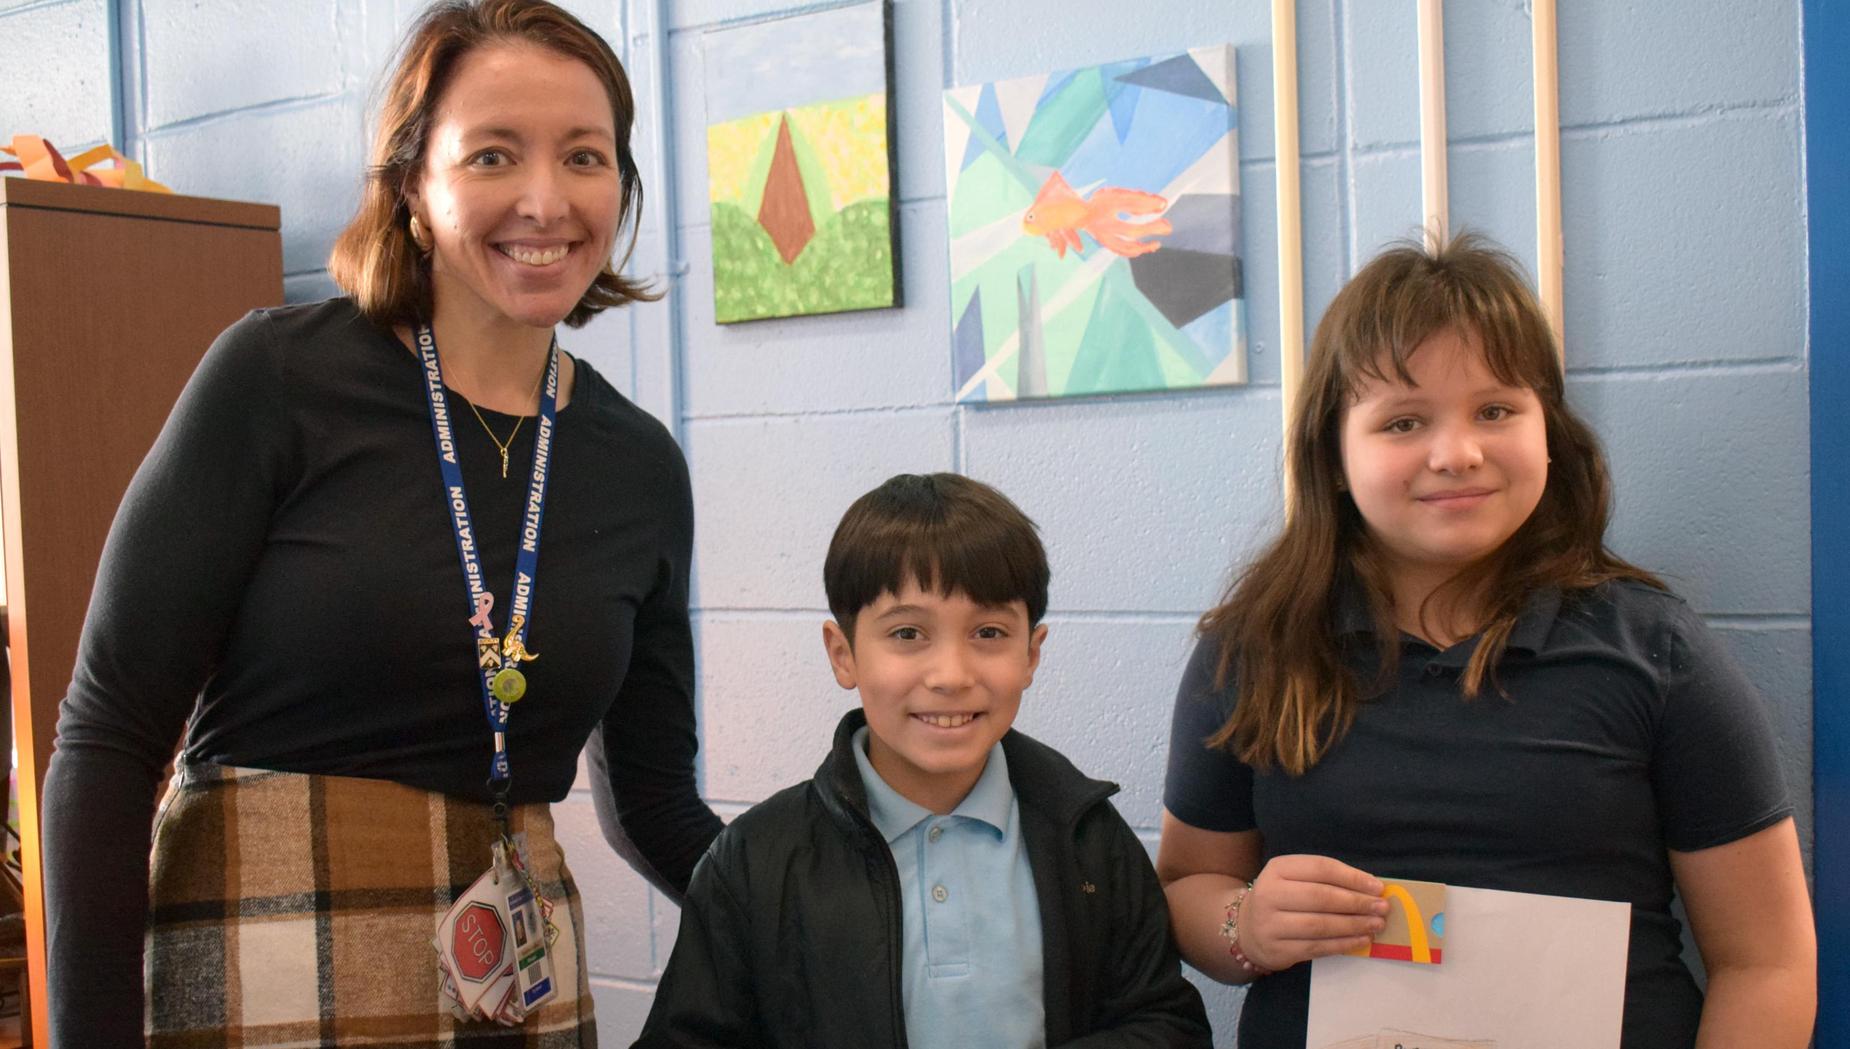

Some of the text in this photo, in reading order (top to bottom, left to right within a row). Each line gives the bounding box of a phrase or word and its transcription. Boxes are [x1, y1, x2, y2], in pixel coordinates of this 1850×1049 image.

[522, 414, 552, 552] ADMINISTRATION
[449, 486, 492, 638] AINISTRATION
[461, 913, 494, 966] STOP
